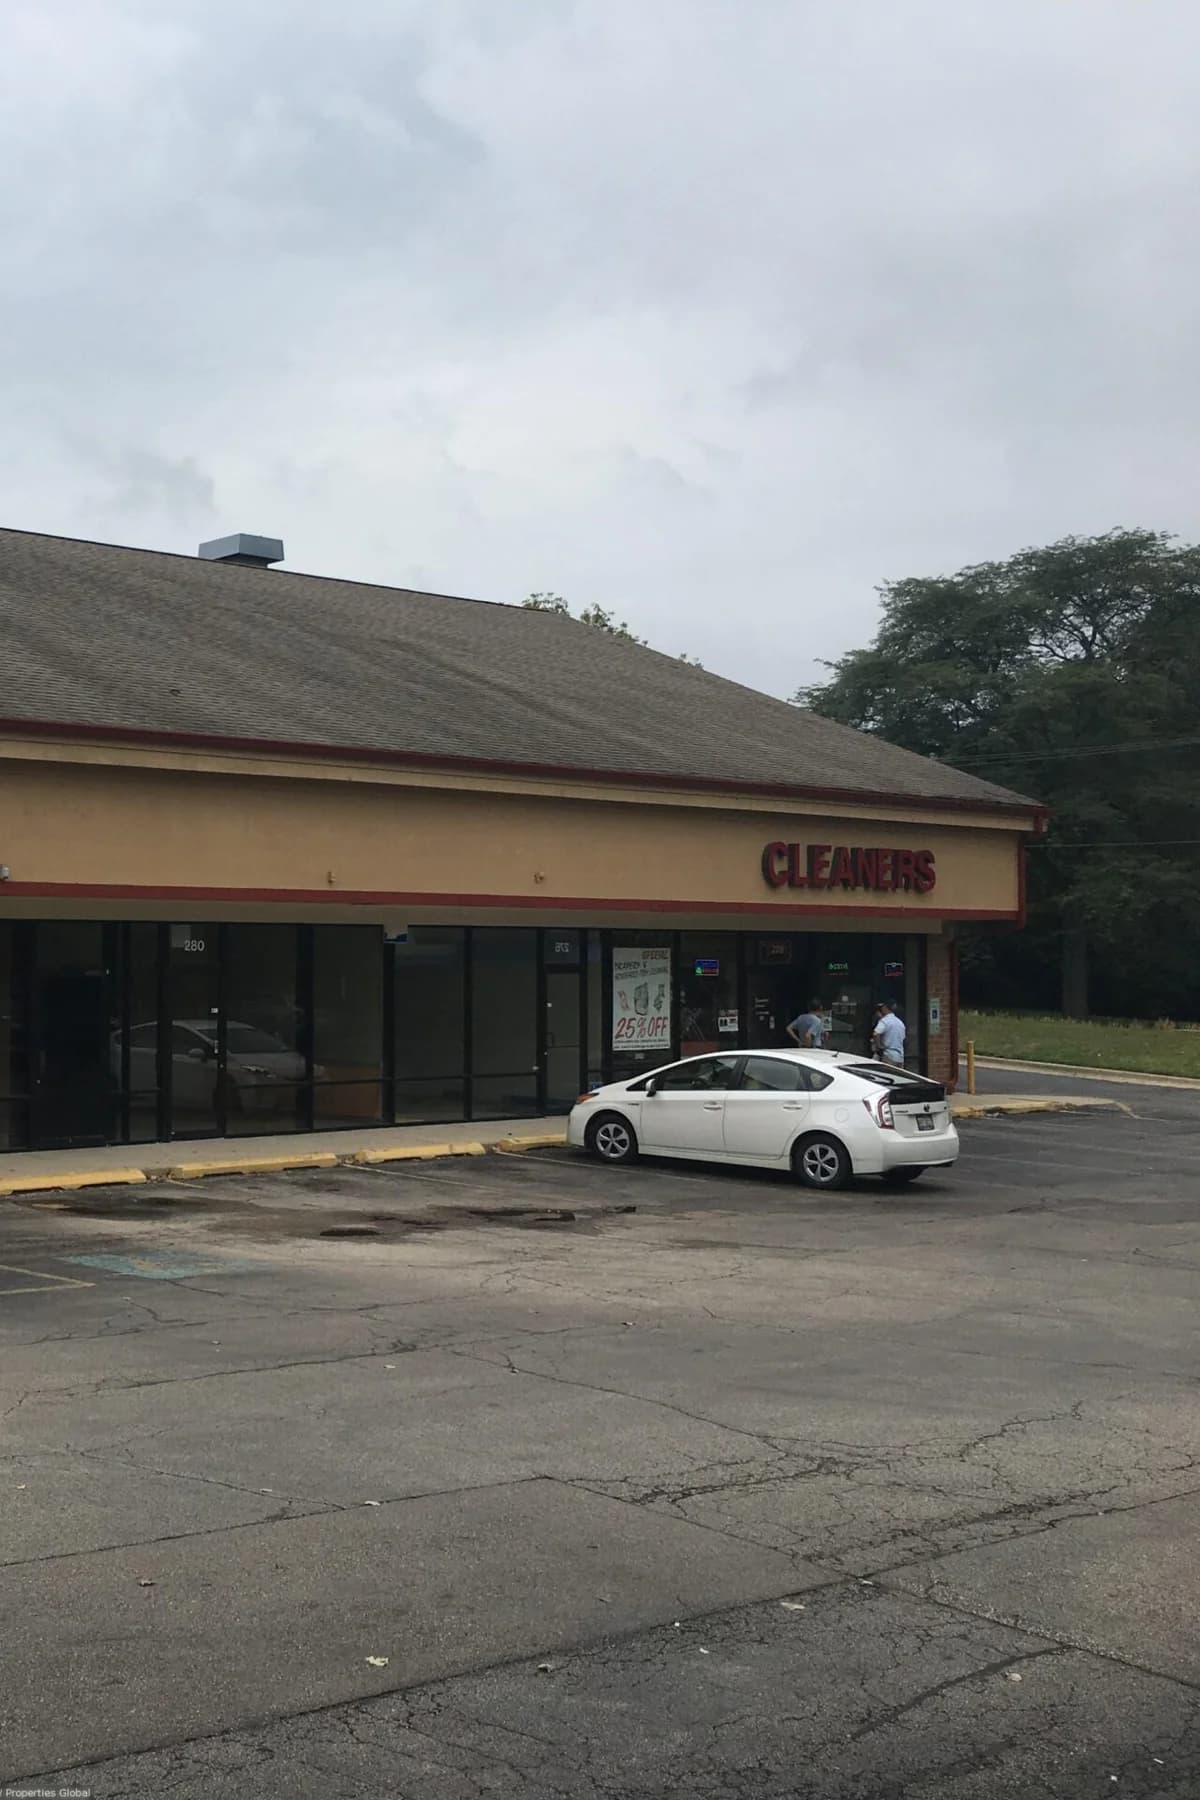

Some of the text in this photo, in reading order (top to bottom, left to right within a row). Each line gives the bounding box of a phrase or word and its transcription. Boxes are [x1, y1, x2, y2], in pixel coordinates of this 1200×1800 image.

[762, 841, 936, 892] CLEANERS
[184, 939, 205, 951] 280
[648, 1016, 668, 1037] OFF
